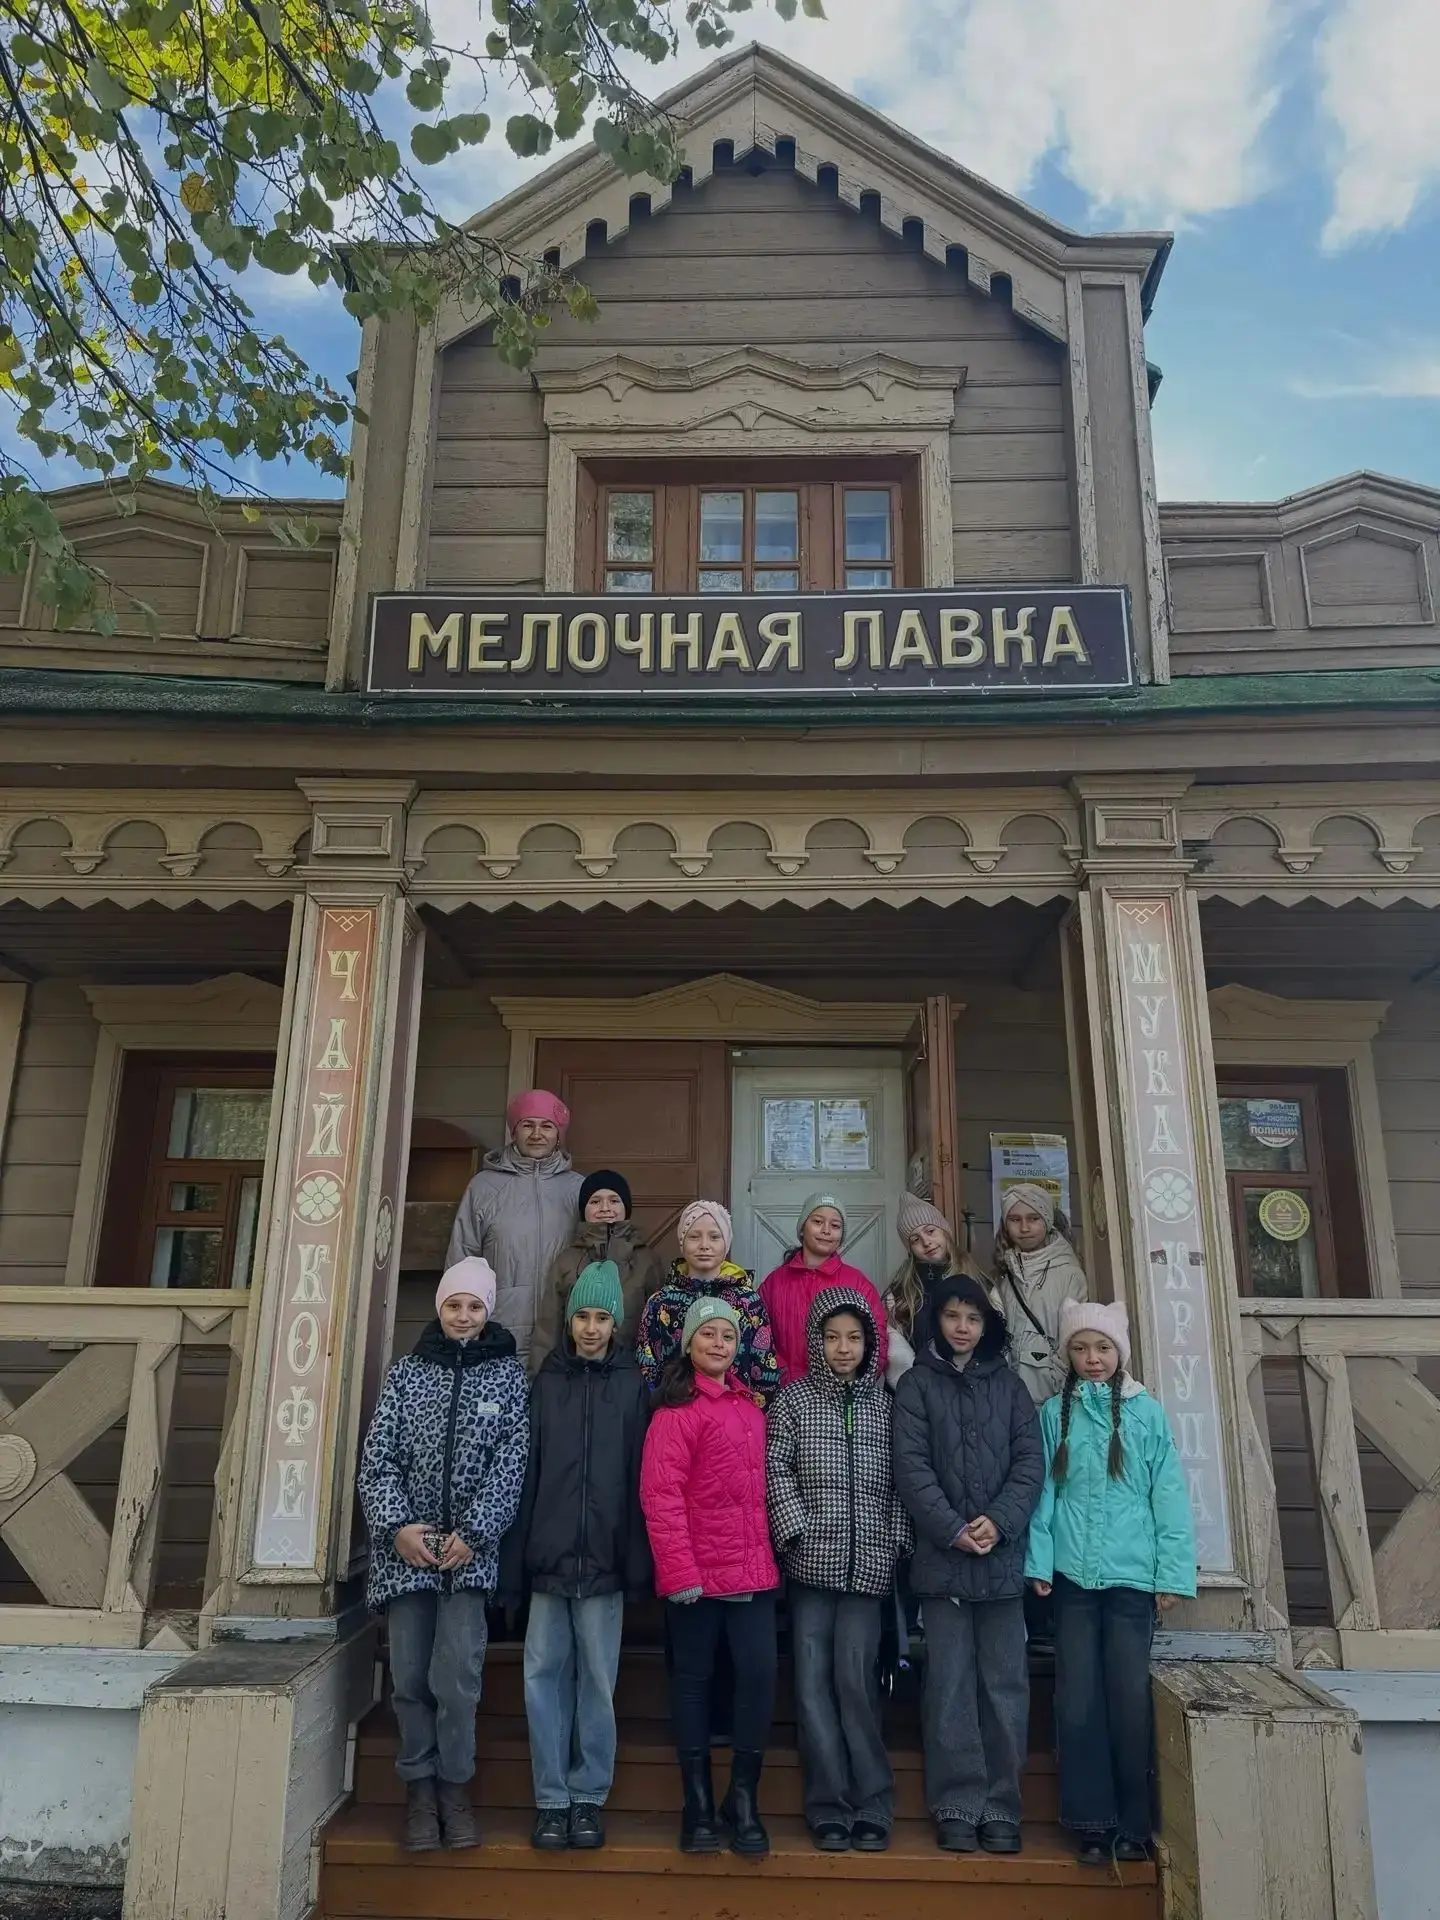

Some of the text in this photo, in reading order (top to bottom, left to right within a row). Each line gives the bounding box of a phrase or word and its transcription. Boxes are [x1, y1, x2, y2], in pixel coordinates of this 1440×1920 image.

[408, 605, 1092, 673] МЕЛОЧНАЯ ЛАВКА
[271, 950, 362, 1520] ЧАЙ КОФЕ
[1129, 943, 1217, 1526] МУКА КРУПА
